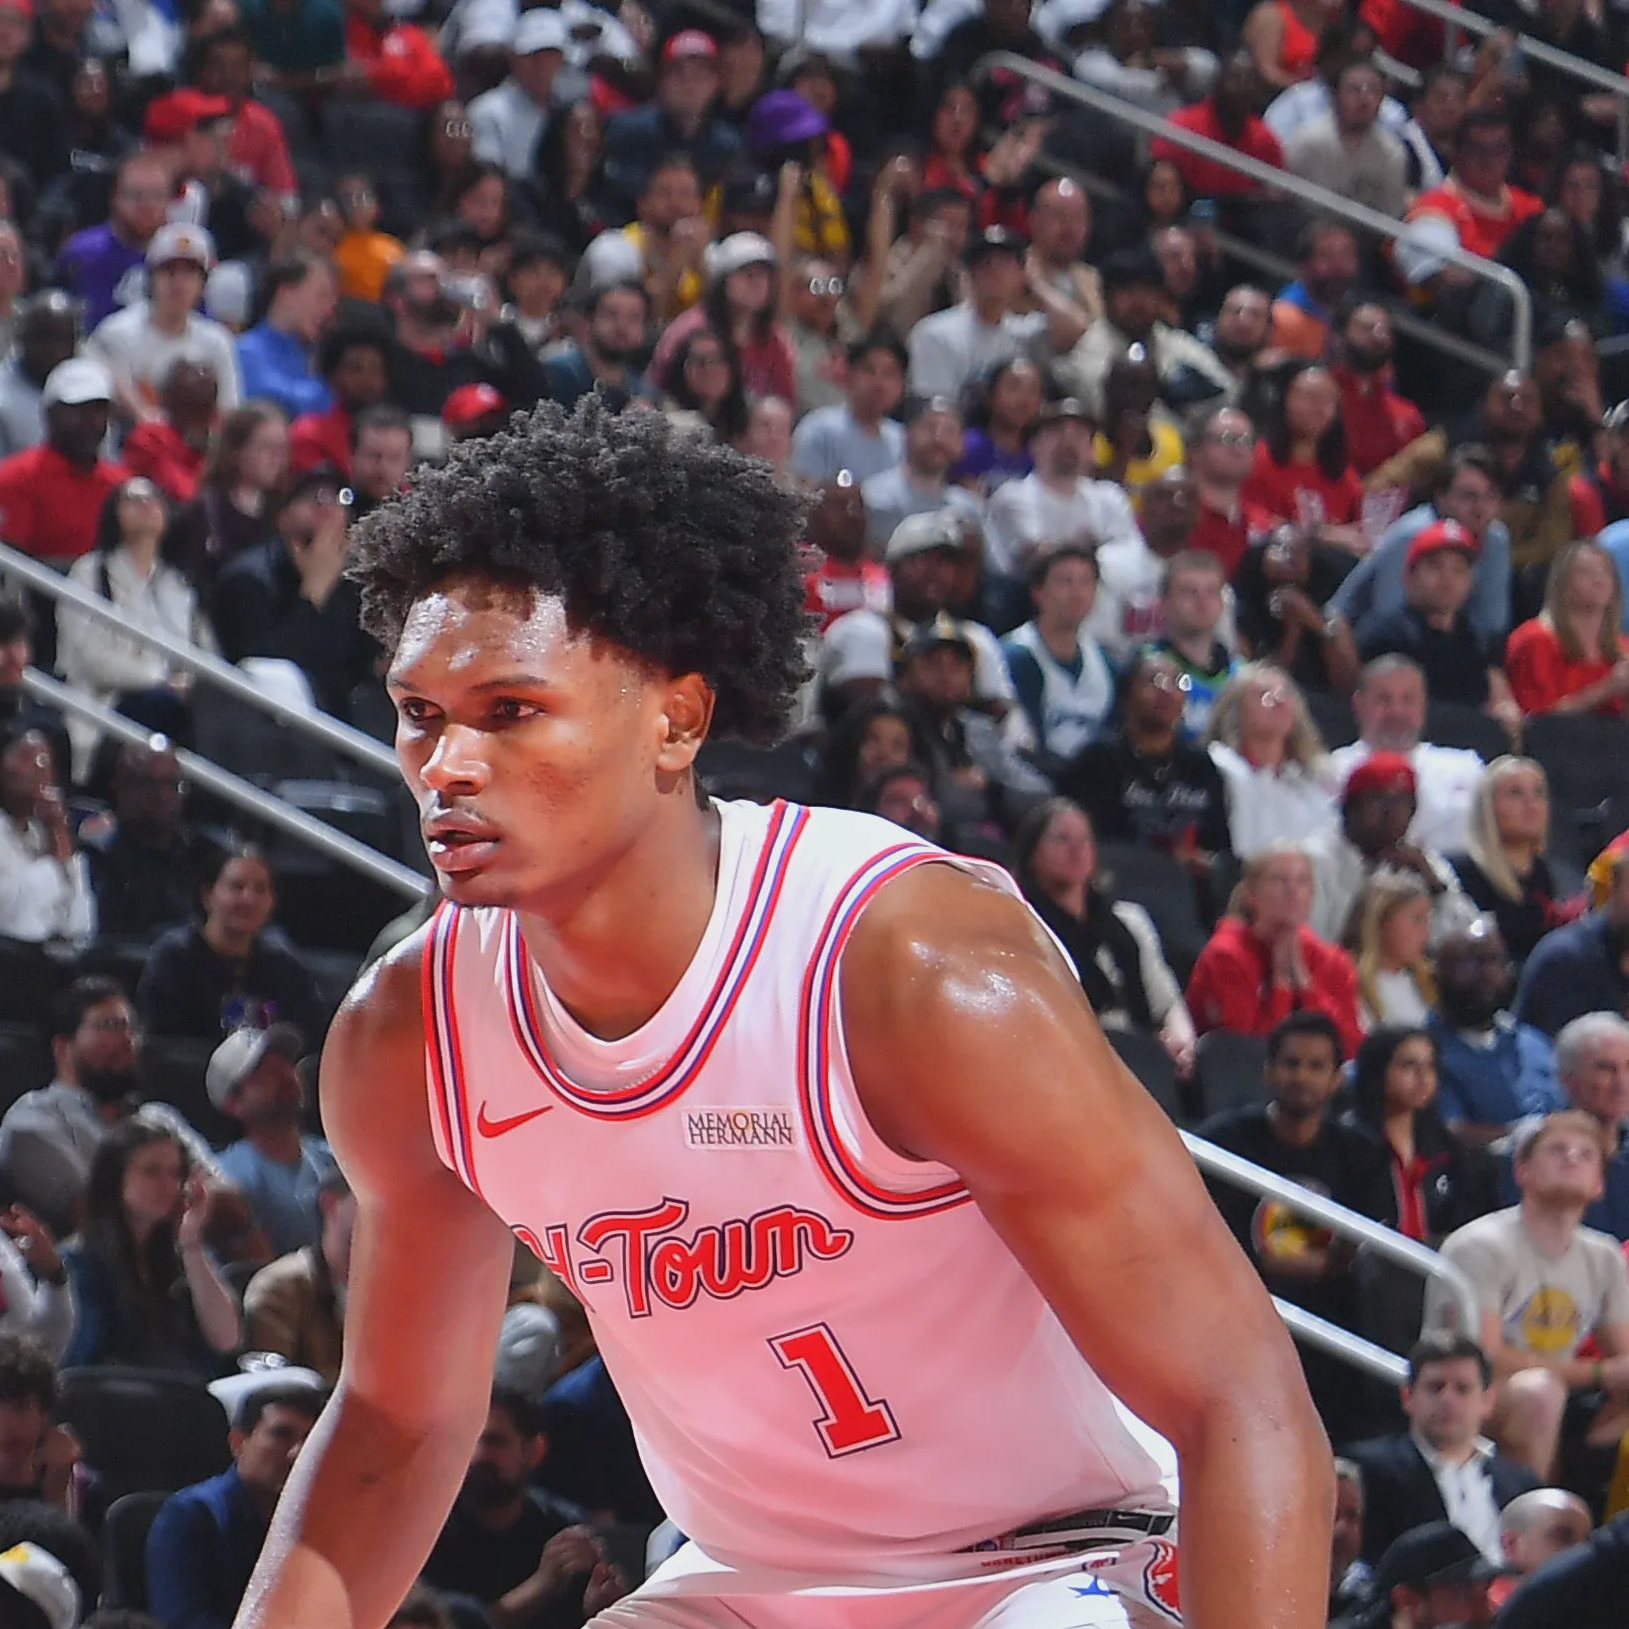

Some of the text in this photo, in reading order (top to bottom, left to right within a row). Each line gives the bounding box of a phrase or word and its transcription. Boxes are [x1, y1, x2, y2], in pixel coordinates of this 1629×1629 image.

[687, 1112, 792, 1131] MEMORIAL
[689, 1127, 793, 1145] HERMANN
[767, 1321, 903, 1460] 1
